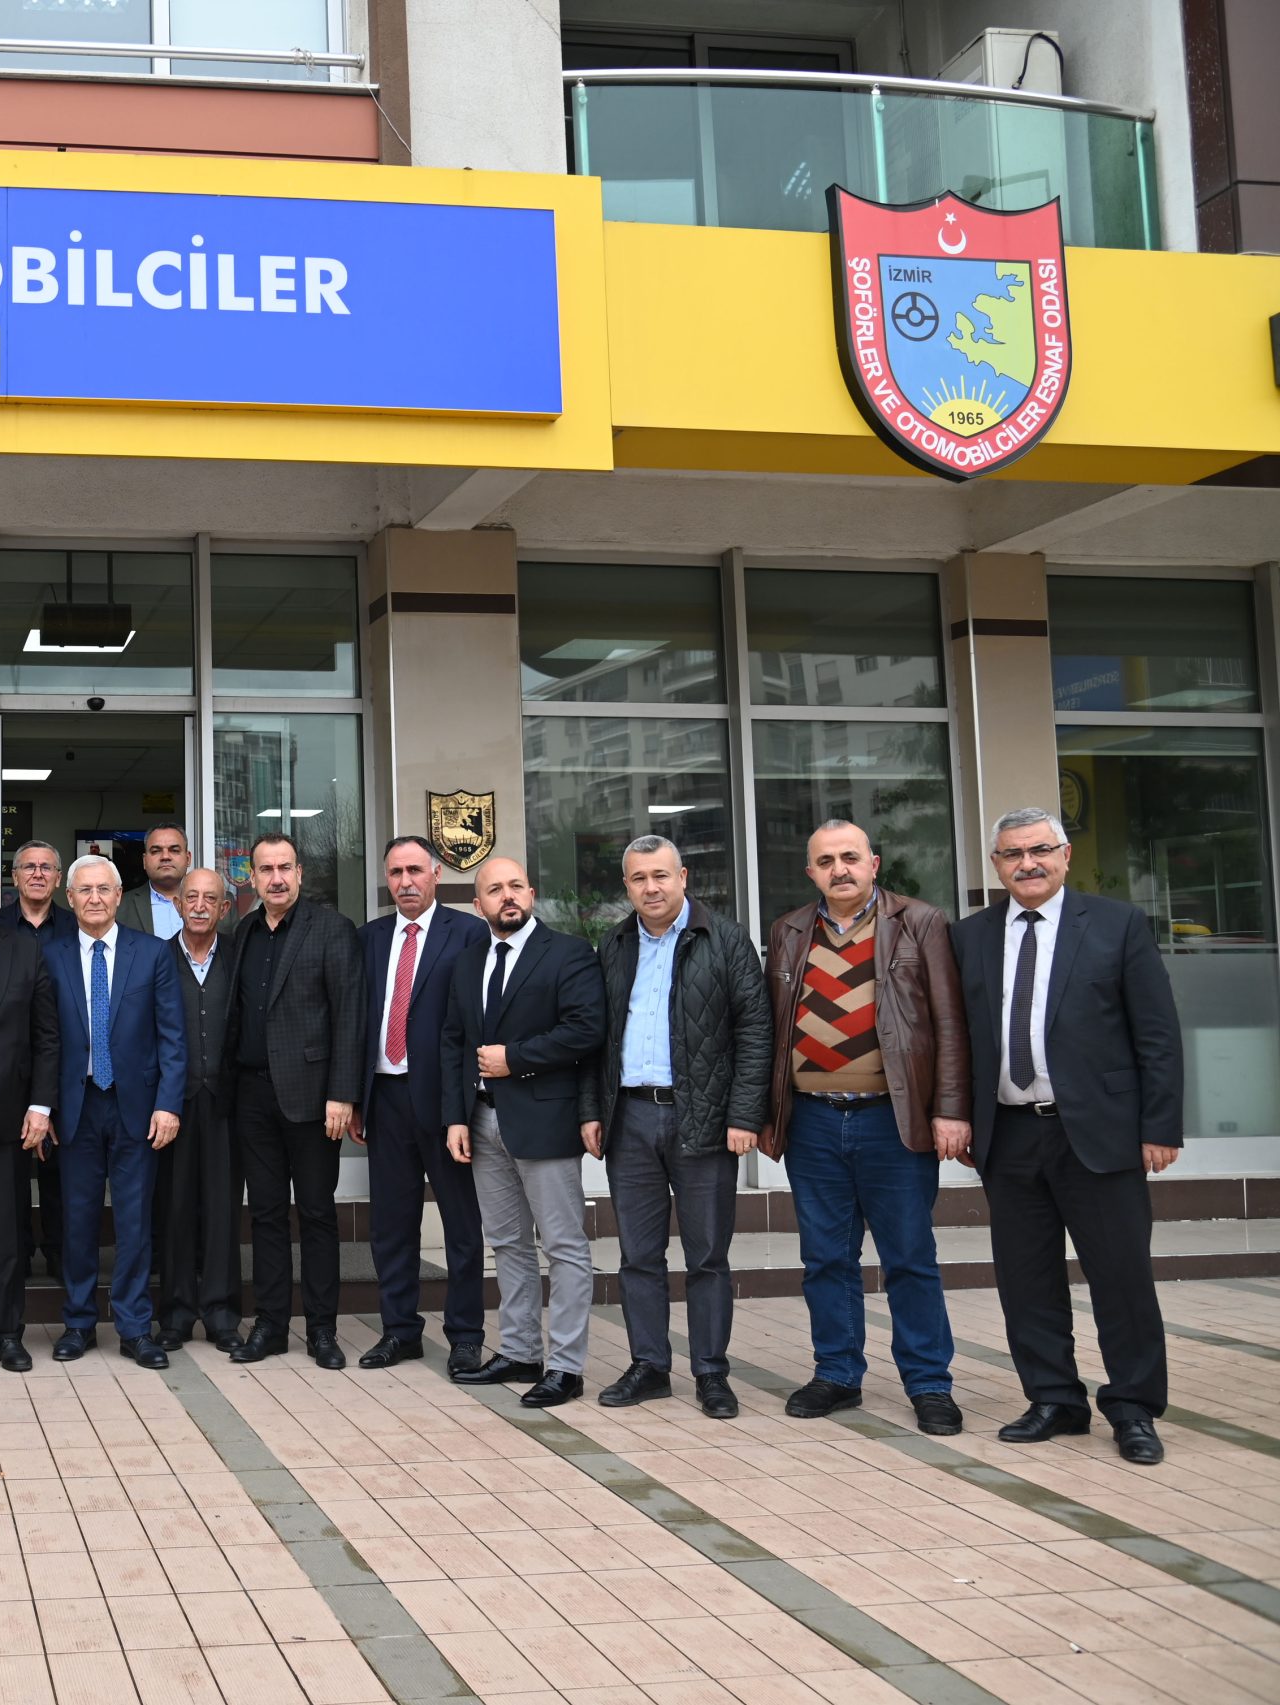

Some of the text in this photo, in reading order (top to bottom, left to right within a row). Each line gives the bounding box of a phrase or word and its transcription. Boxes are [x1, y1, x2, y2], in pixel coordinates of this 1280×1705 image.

[888, 264, 933, 284] İZMİR
[847, 256, 1063, 466] ŞOFÖRLER VE OTOMOBİLCİLER ESNAF ODASI
[948, 411, 984, 426] 1965
